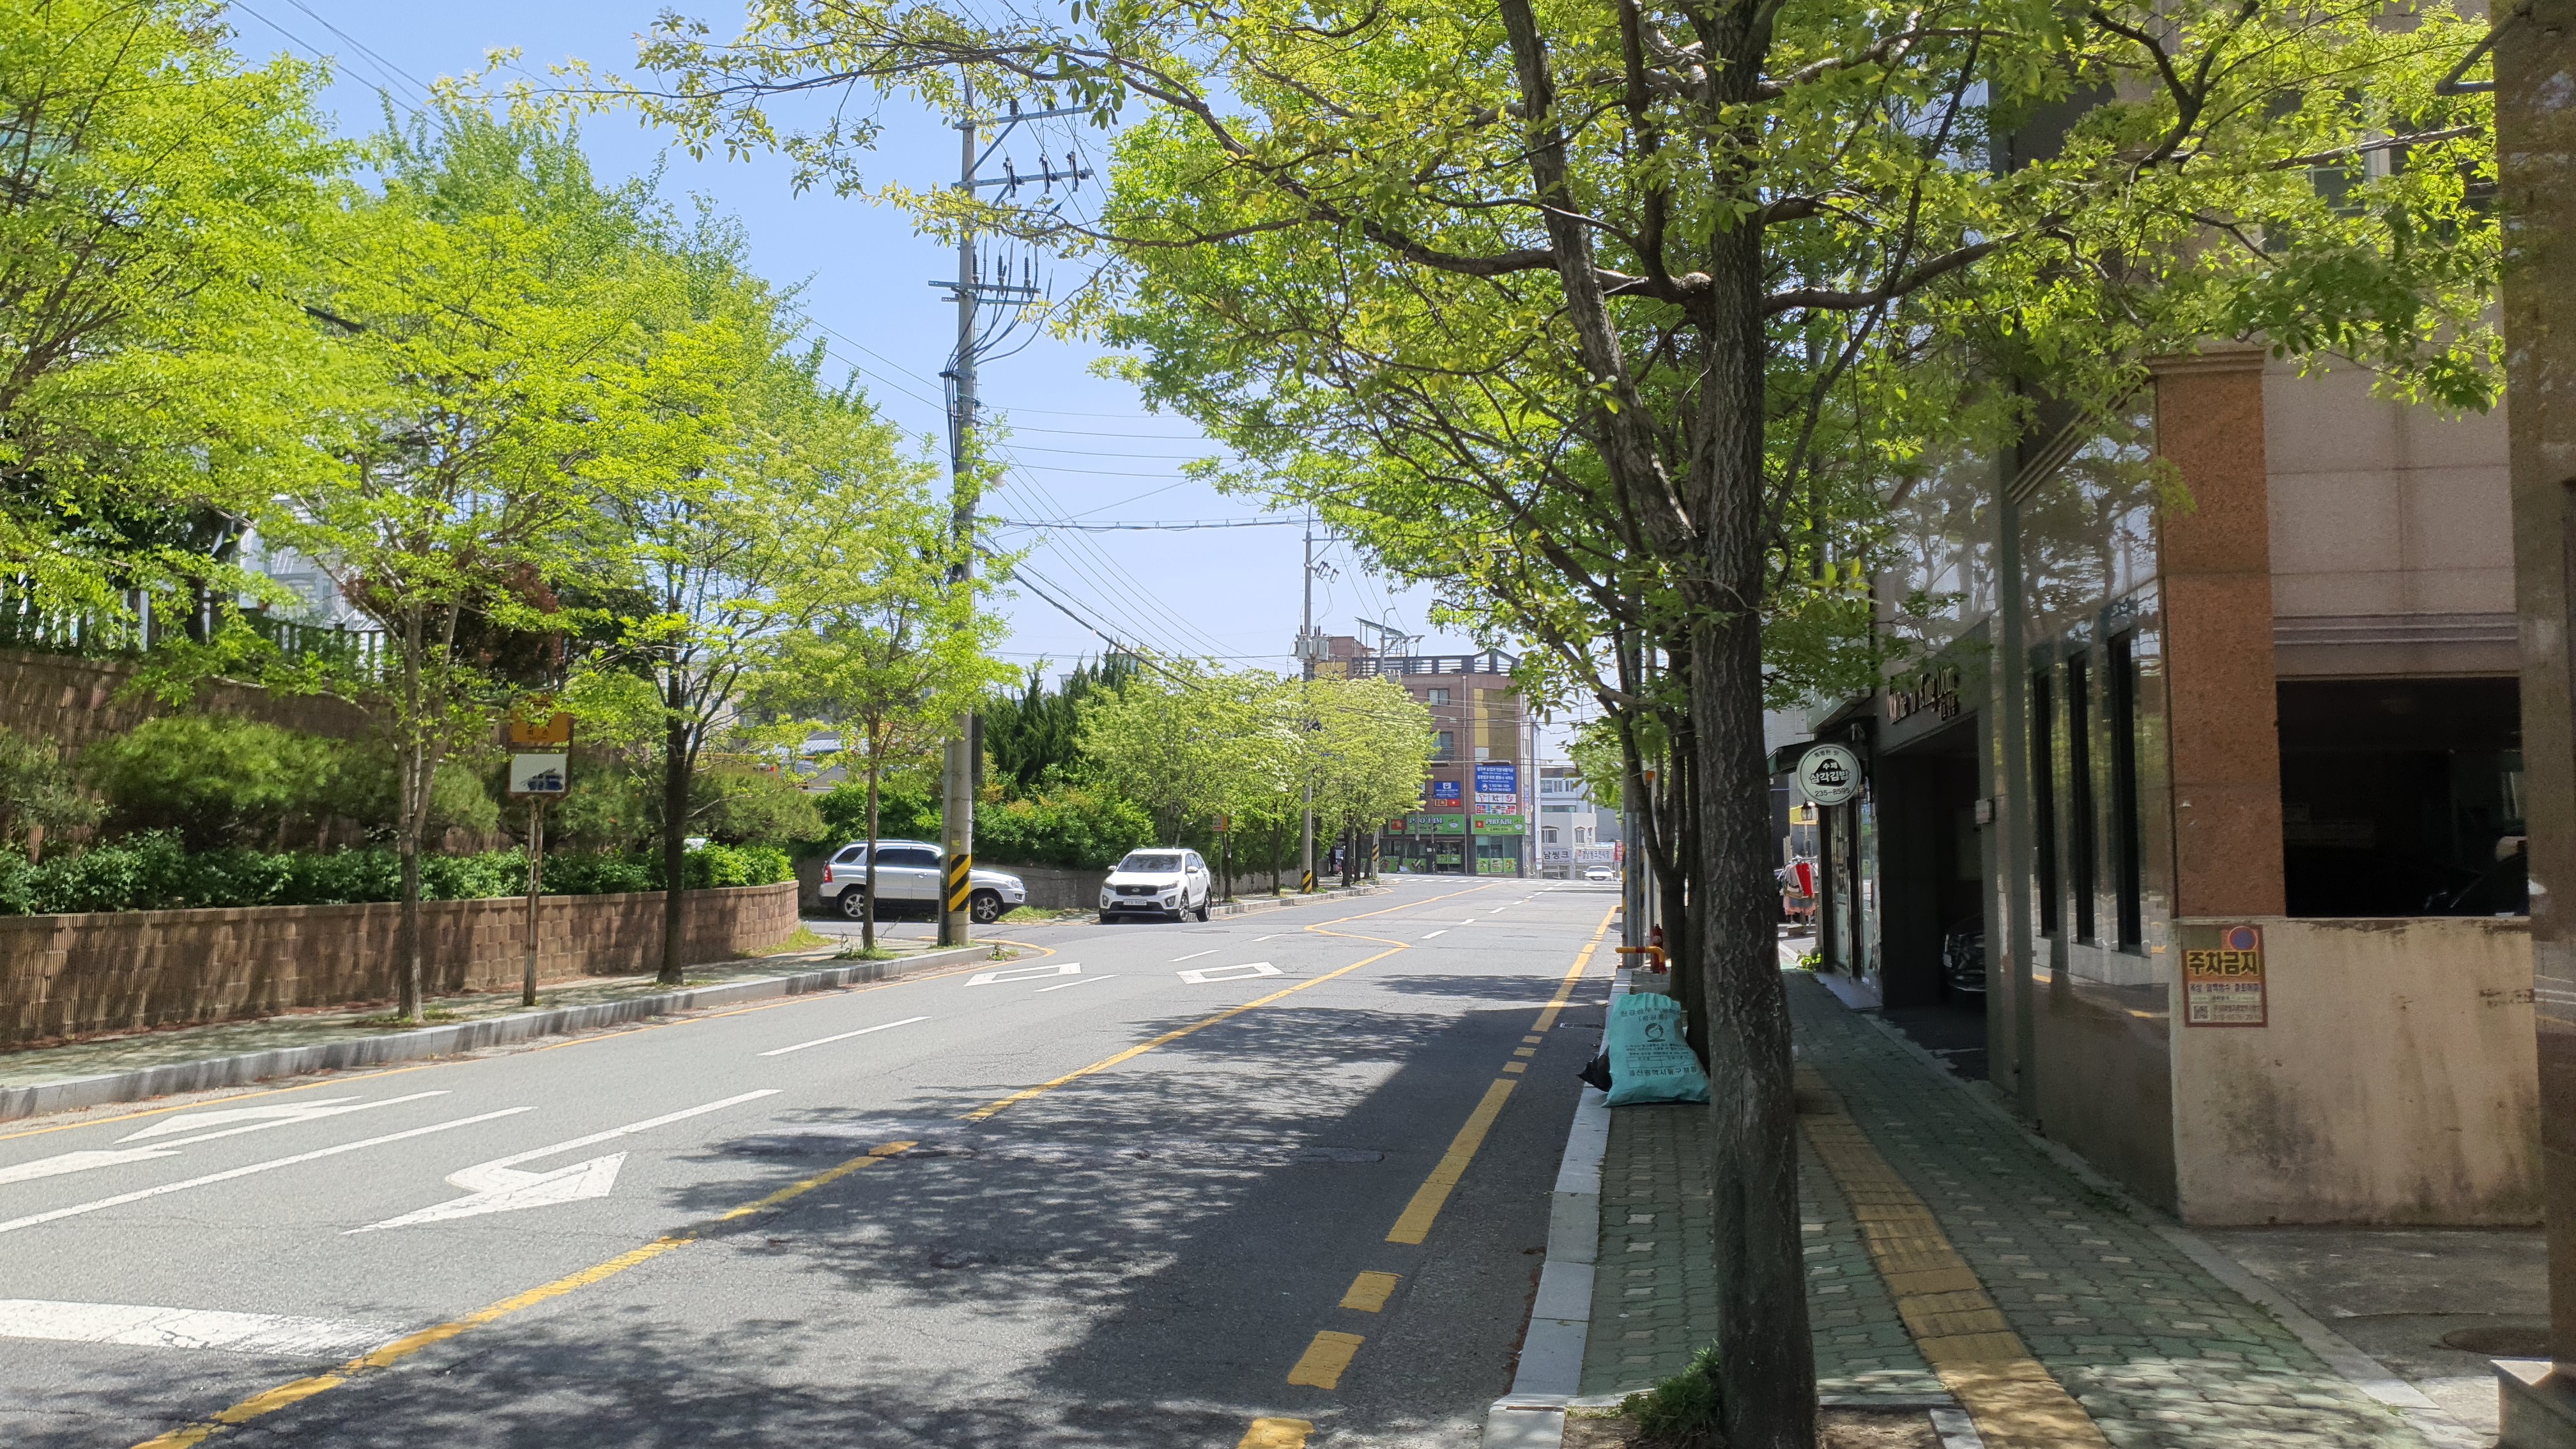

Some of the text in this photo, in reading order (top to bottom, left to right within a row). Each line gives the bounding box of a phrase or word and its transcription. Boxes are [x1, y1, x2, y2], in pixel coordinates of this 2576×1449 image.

[1822, 762, 1838, 770] 수제
[1810, 769, 1850, 784] 삼각김밥
[1815, 788, 1851, 797] 235-8595
[2188, 951, 2258, 976] 주차금지
